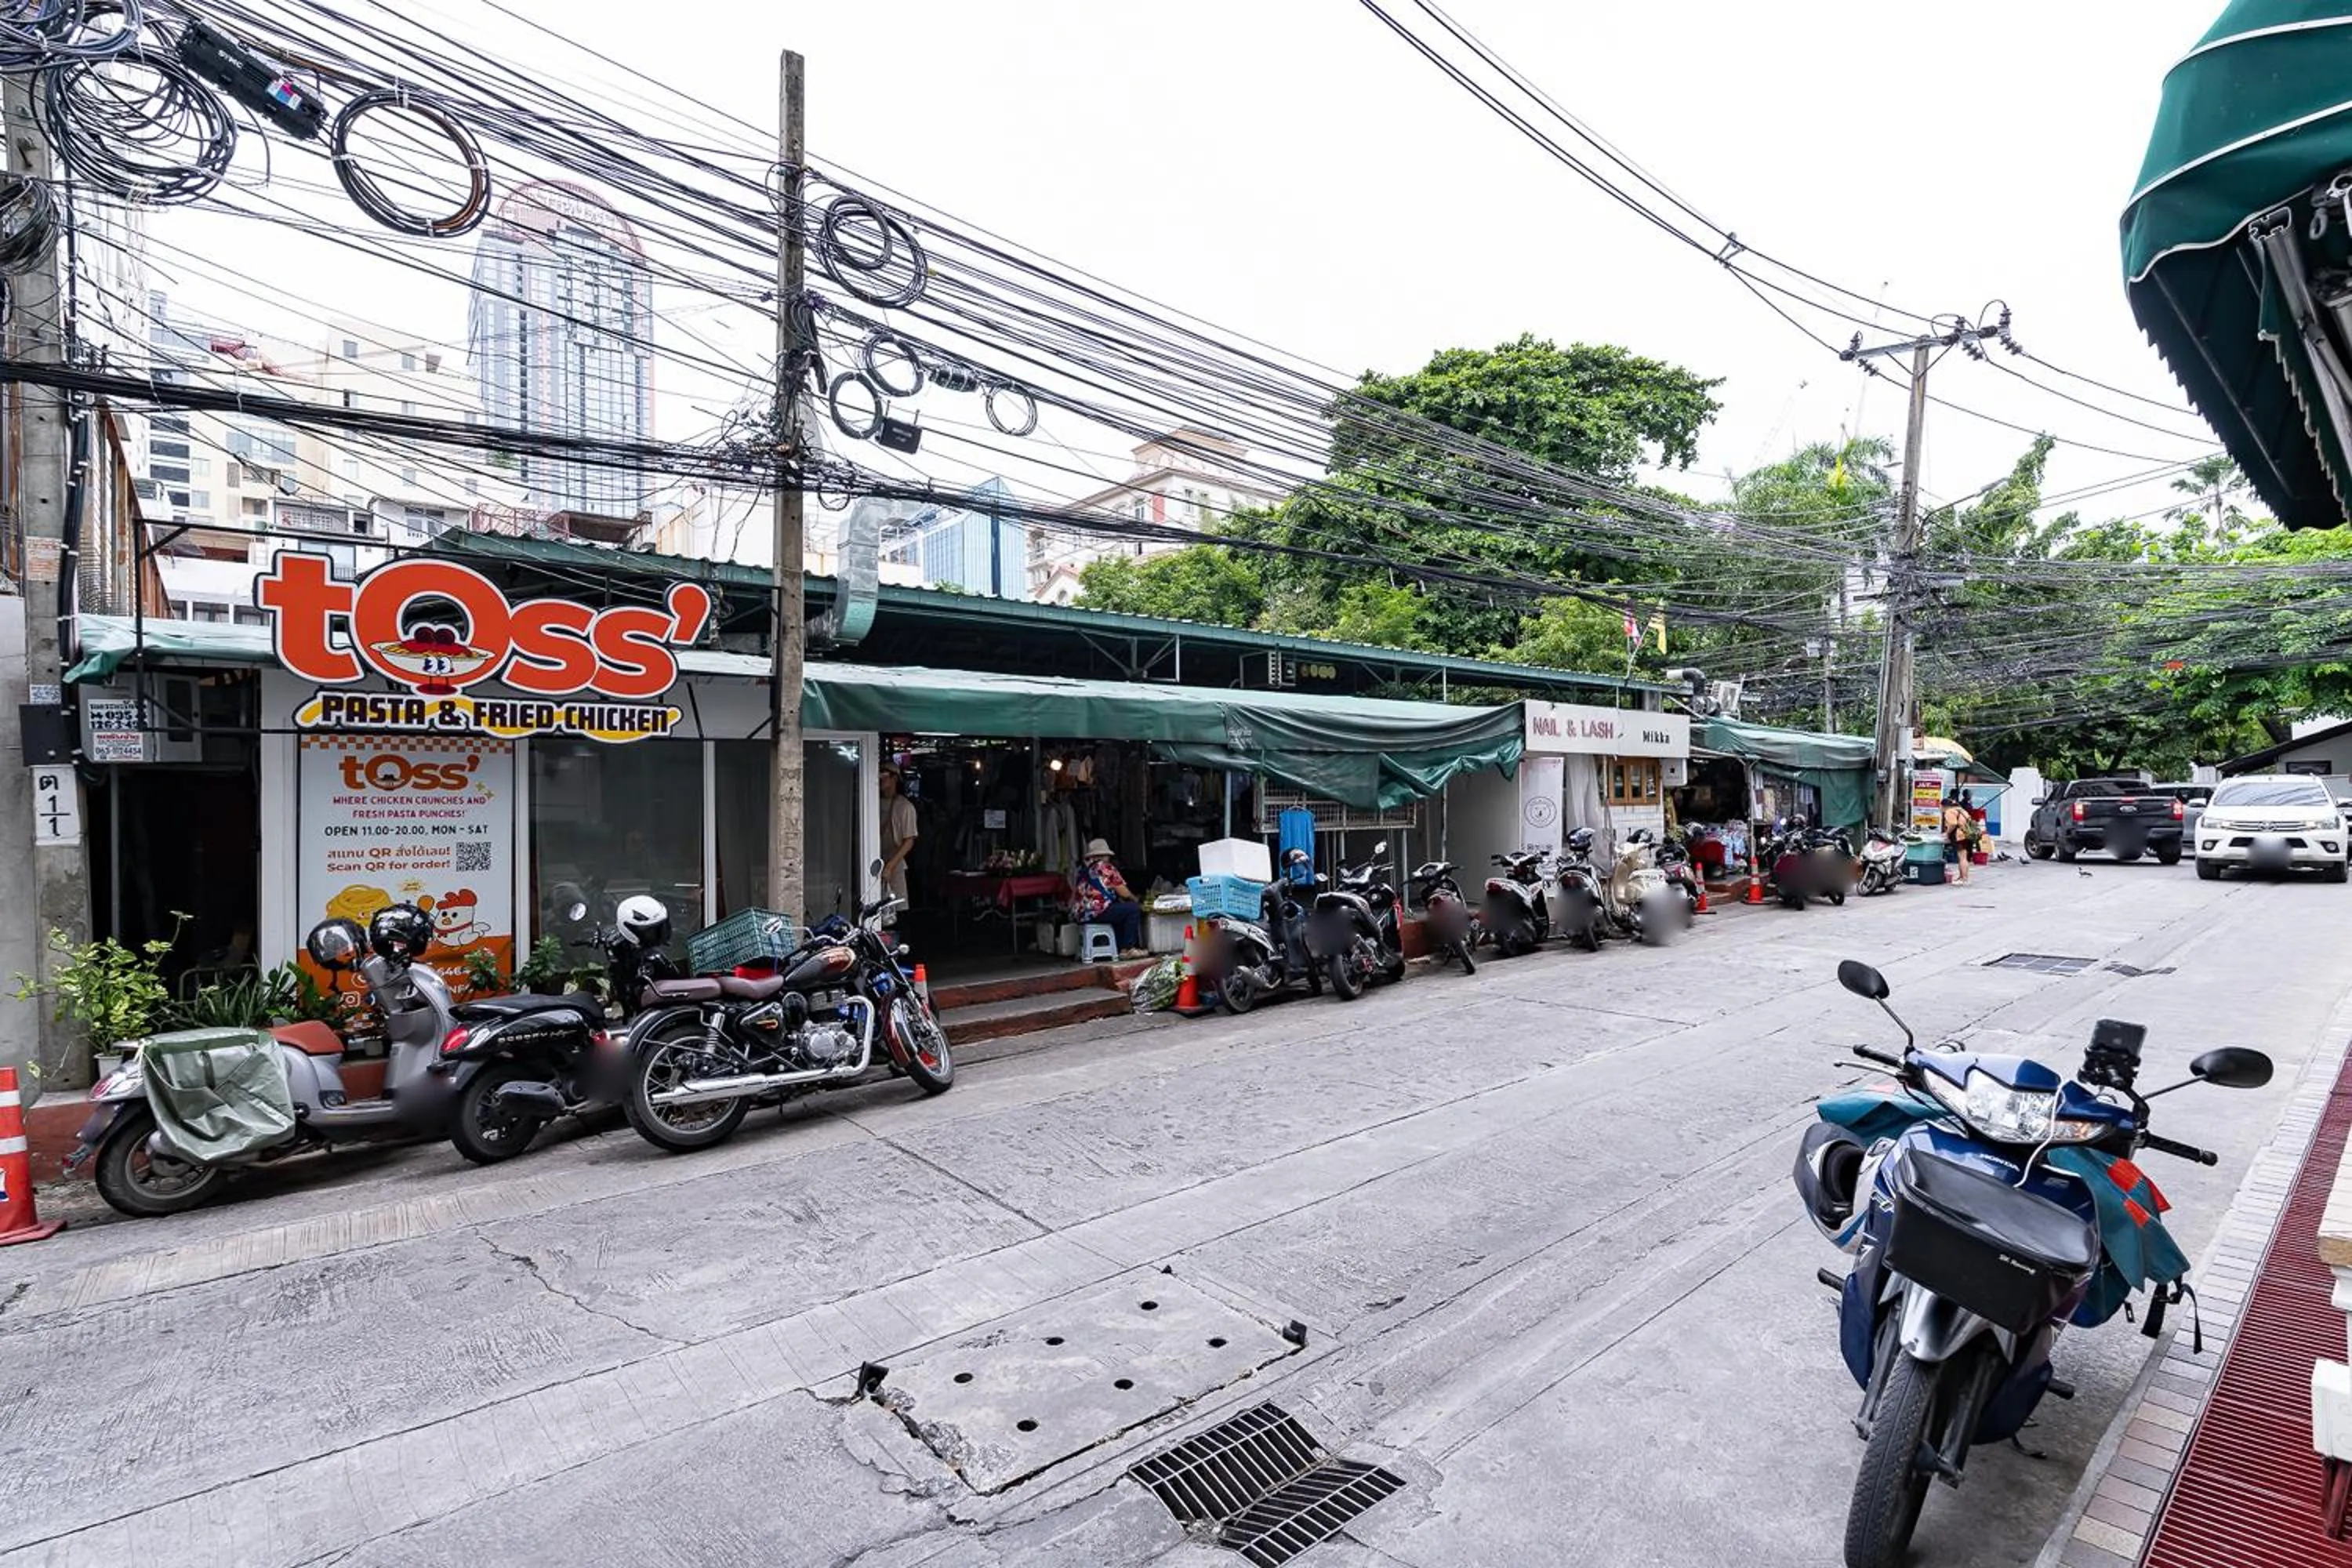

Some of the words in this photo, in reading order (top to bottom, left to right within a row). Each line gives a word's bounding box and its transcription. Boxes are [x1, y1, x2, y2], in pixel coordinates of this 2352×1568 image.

[321, 694, 426, 726] PASTA
[438, 698, 466, 728] &
[474, 702, 555, 730] FRIED
[564, 705, 670, 734] CHICKEN
[1533, 717, 1561, 738] NAIL
[1566, 718, 1577, 738] &
[1581, 719, 1614, 739] LASH
[332, 796, 368, 805] WHERE
[371, 796, 413, 805] CHICKEN
[415, 796, 465, 805] CRUNCHES
[466, 796, 488, 805] AND
[352, 810, 385, 819] FRESH
[387, 810, 416, 818] PASTA
[419, 809, 466, 818] PUNCHES!
[324, 826, 359, 837] OPEN
[430, 825, 457, 836] MON
[467, 824, 489, 834] SAT
[327, 848, 365, 859] สแกน
[368, 848, 392, 858] QR
[326, 862, 362, 873] Scan
[365, 862, 387, 873] QR
[389, 861, 408, 871] for
[411, 860, 451, 870] order!
[1980, 1153, 2020, 1172] HONDA
